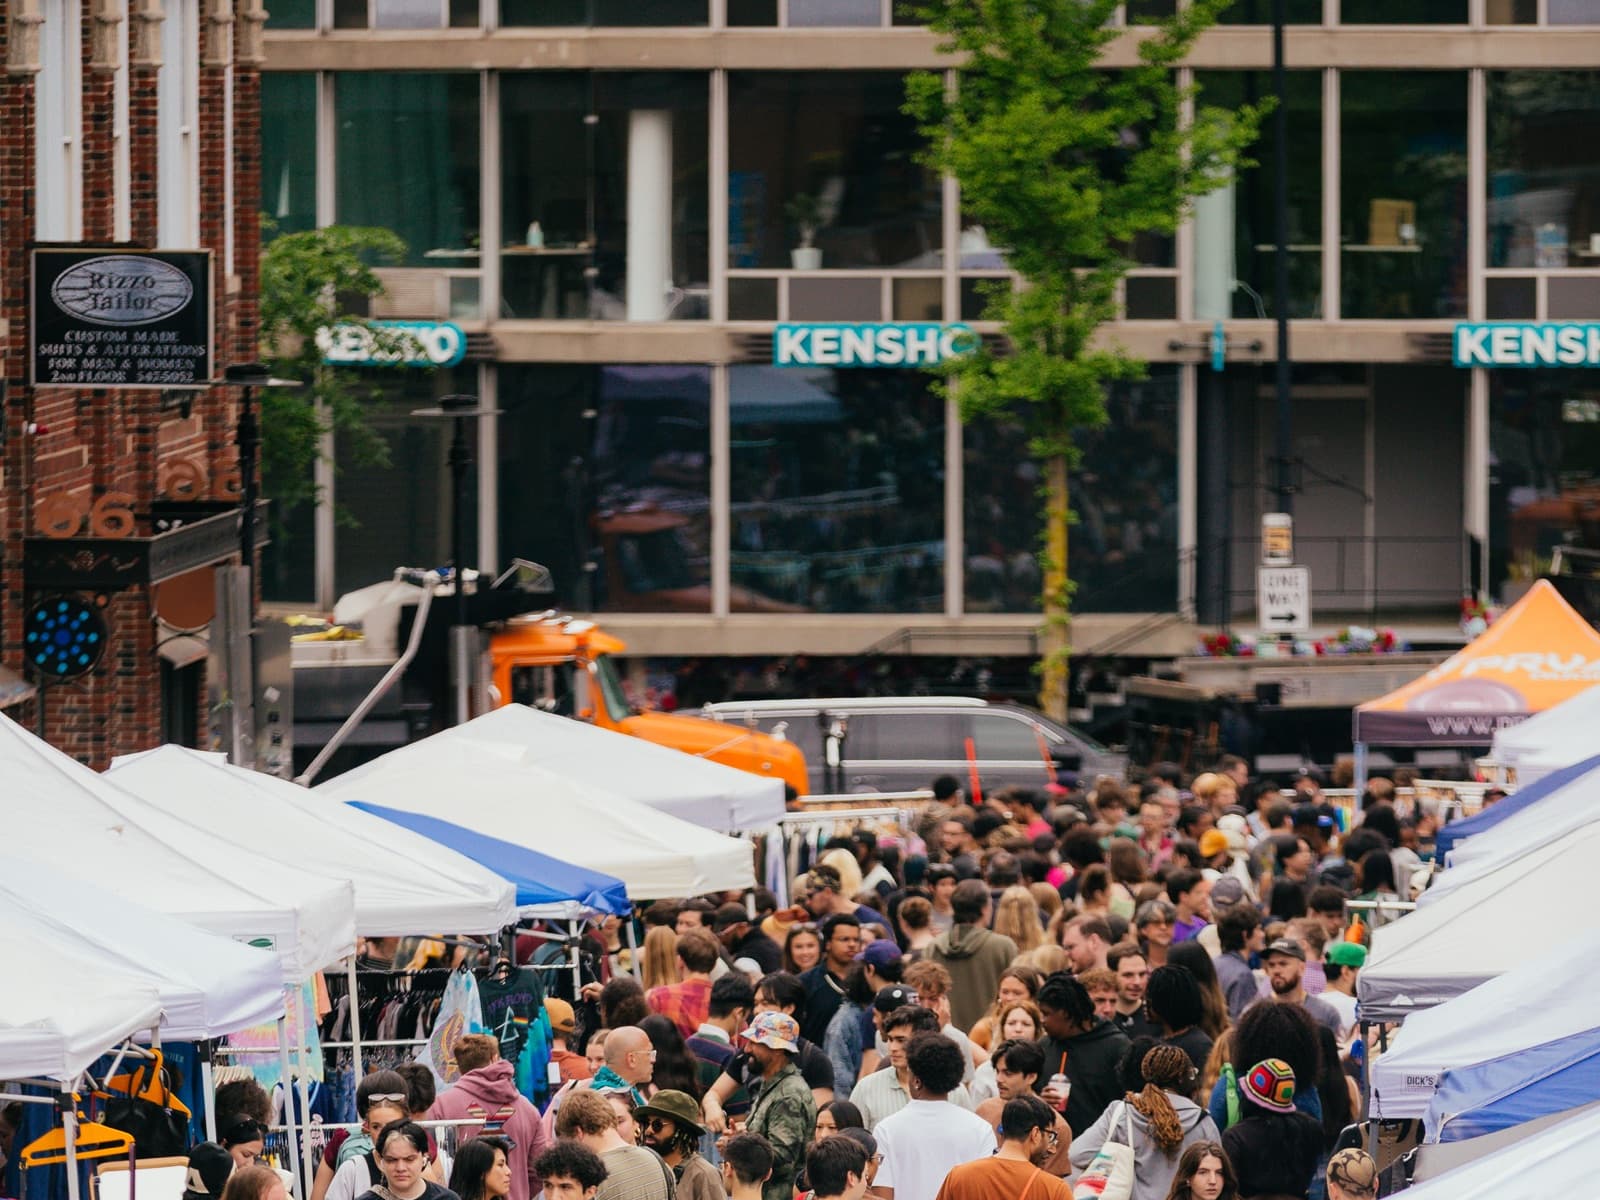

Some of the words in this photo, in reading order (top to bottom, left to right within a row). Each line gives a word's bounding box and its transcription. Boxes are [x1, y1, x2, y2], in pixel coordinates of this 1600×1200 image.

[90, 272, 156, 289] Rizzo
[90, 290, 155, 310] Tailor
[64, 330, 128, 342] CUSTOM
[133, 331, 179, 342] MADE
[38, 344, 83, 355] SUITS
[86, 345, 98, 355] &
[103, 344, 206, 356] ALTERATIONS
[48, 358, 77, 369] FOR
[81, 359, 116, 369] MEN
[120, 359, 131, 369] &
[137, 359, 195, 369] WOMEN
[1407, 1075, 1434, 1086] DICK'S
